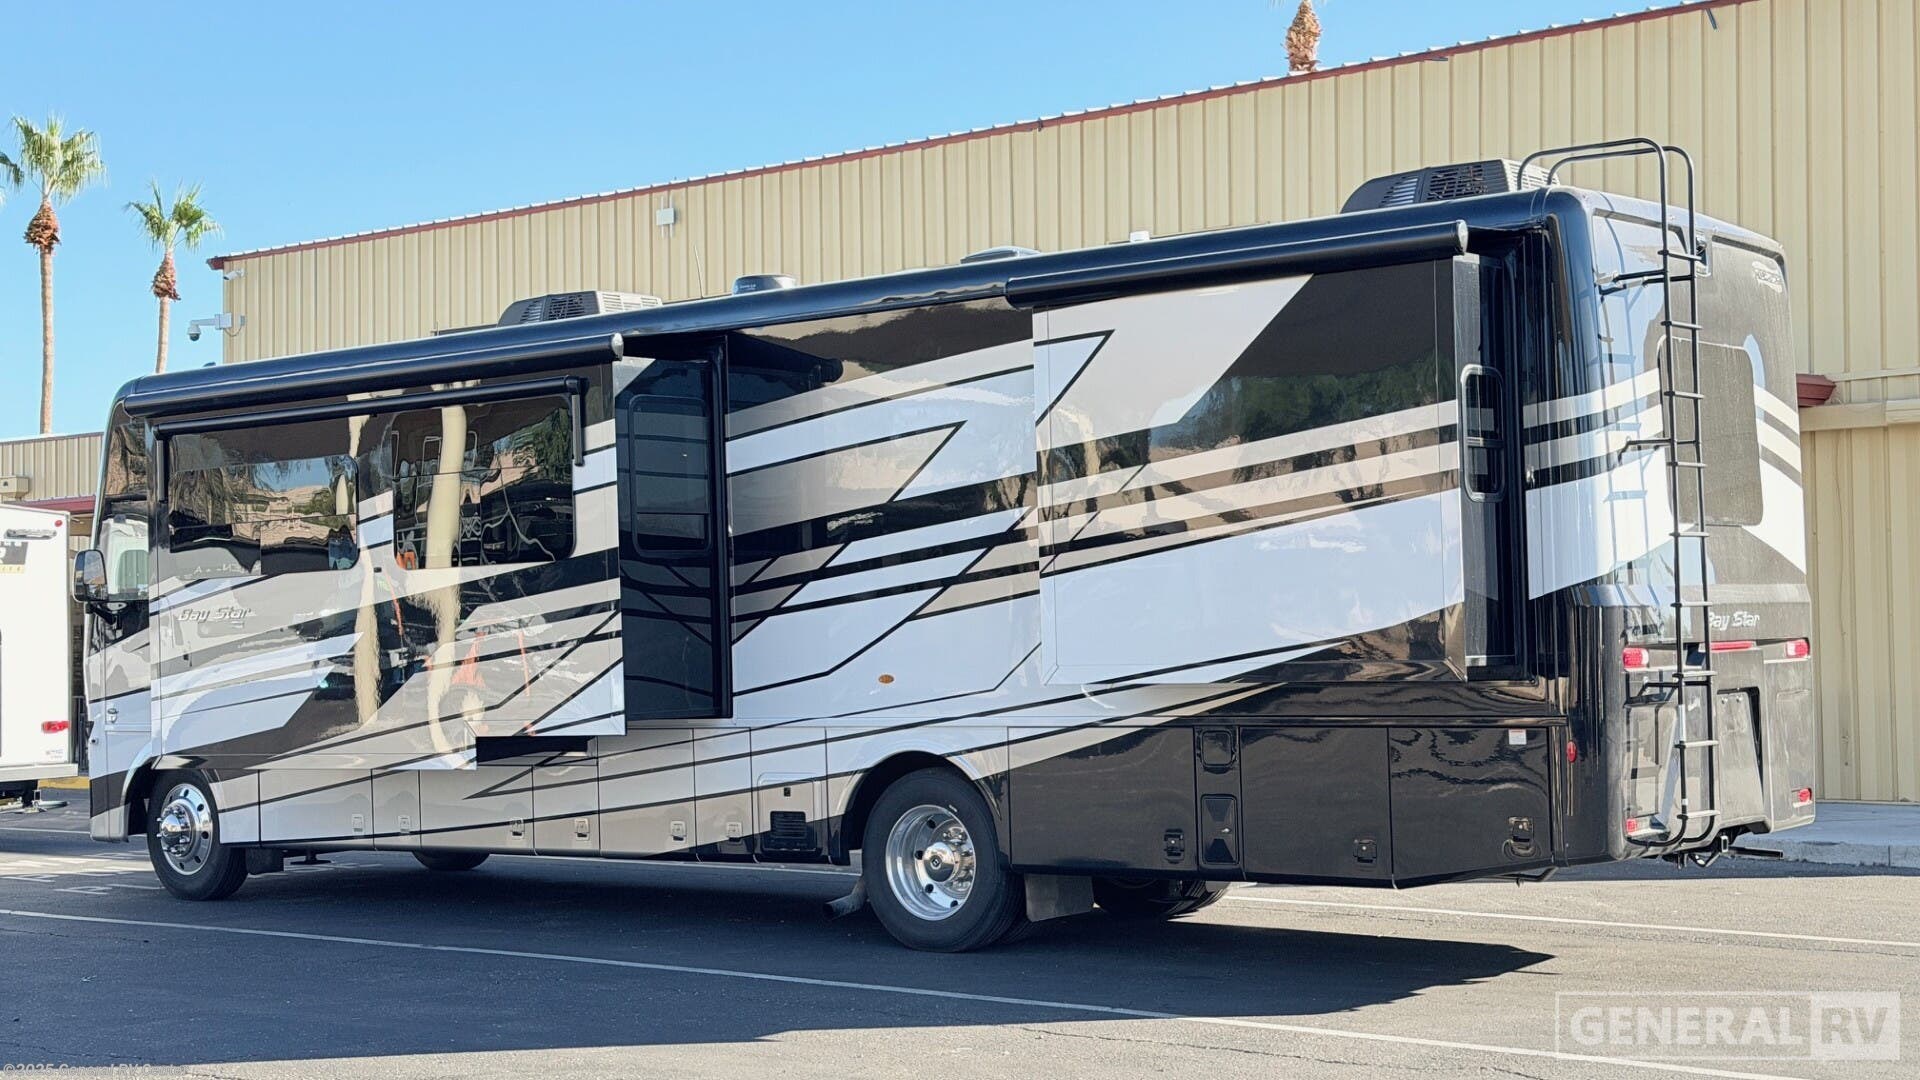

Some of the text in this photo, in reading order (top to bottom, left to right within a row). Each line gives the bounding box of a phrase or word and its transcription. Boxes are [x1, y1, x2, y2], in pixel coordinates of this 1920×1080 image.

[178, 606, 252, 624] Bay Star
[1732, 610, 1760, 627] Star
